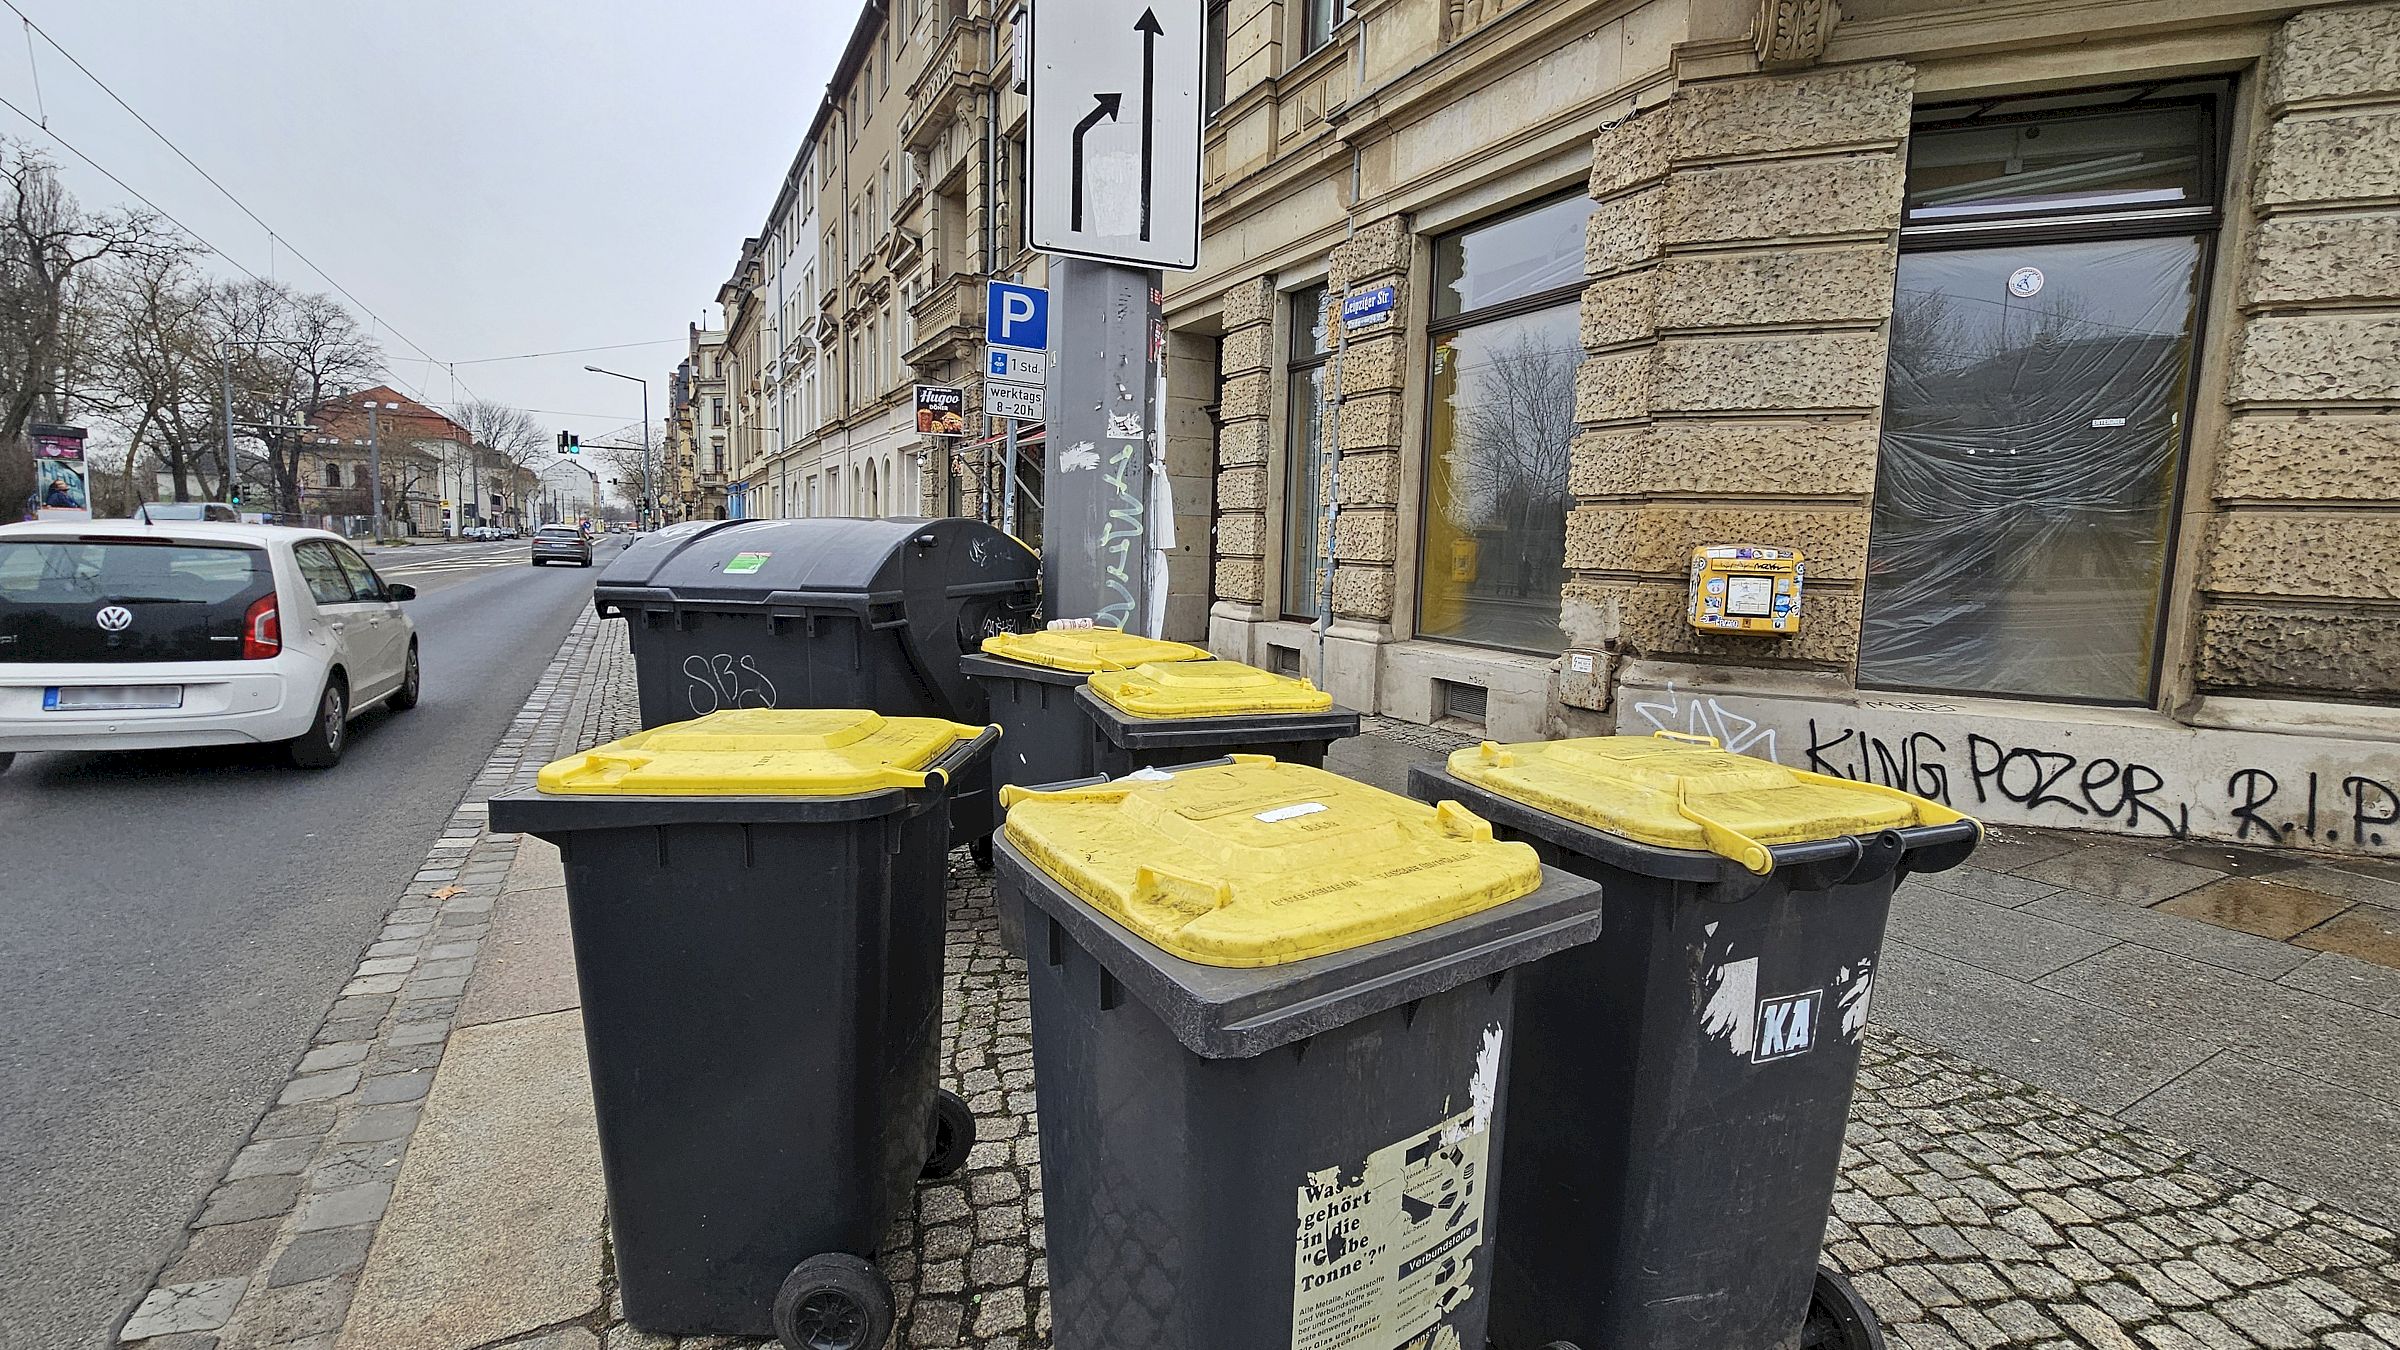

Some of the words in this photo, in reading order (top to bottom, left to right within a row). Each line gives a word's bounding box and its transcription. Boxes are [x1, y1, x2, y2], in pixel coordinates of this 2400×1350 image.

[1002, 291, 1035, 338] P
[1344, 295, 1376, 314] Leipziger
[1376, 290, 1390, 305] Str.
[1011, 358, 1017, 371] 1
[1020, 362, 1040, 374] Std.
[920, 390, 960, 406] Hugoo
[990, 387, 1041, 404] werktags
[1807, 718, 1948, 806] KING
[1760, 998, 1810, 1056] KA
[1304, 1190, 1372, 1231] gehört
[1305, 1183, 1343, 1204] Was
[1302, 1231, 1322, 1250] in
[1331, 1217, 1360, 1237] die
[1408, 1227, 1472, 1272] Verbundstoffe
[1298, 1306, 1314, 1317] Alle
[1315, 1295, 1343, 1310] Metalle,
[1345, 1275, 1385, 1298] Kunststoffe
[1298, 1315, 1313, 1326] und
[1315, 1294, 1365, 1319] Verbundstoffe
[1297, 1332, 1316, 1345] reste
[1317, 1315, 1356, 1337] einwerfen!
[1298, 1325, 1311, 1335] ber
[1312, 1319, 1326, 1330] und
[1327, 1311, 1346, 1324] ohne
[1347, 1300, 1373, 1315] Inhalts-
[1314, 1337, 1333, 1349] Glas
[1335, 1327, 1352, 1340] und
[1353, 1314, 1380, 1332] Papier
